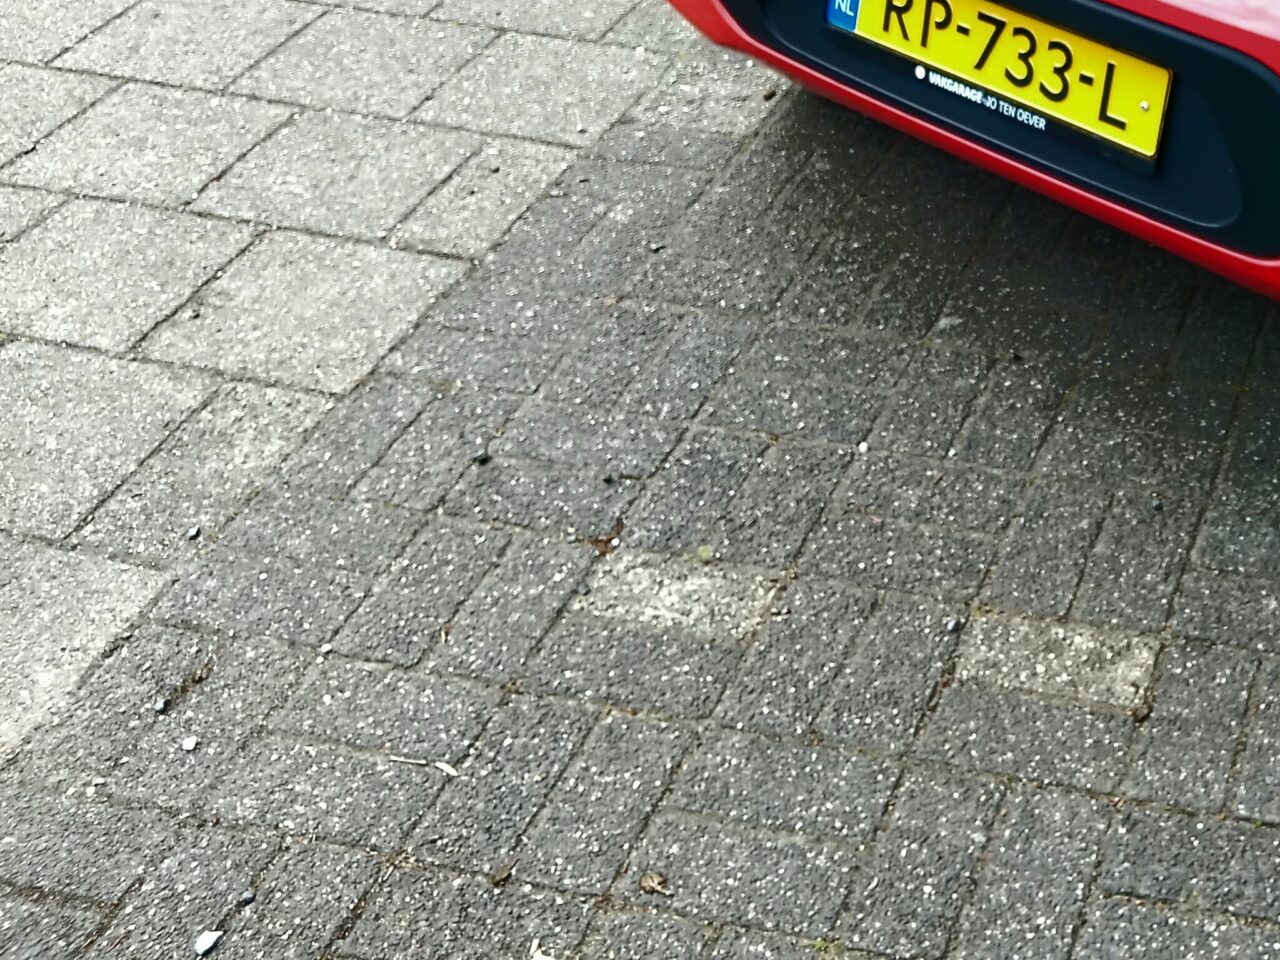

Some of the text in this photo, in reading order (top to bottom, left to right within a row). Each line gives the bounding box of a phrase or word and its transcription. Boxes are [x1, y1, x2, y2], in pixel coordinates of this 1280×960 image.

[928, 71, 983, 104] VAKGARAGE
[999, 100, 1016, 118] TEN
[1016, 109, 1046, 130] OEVER
